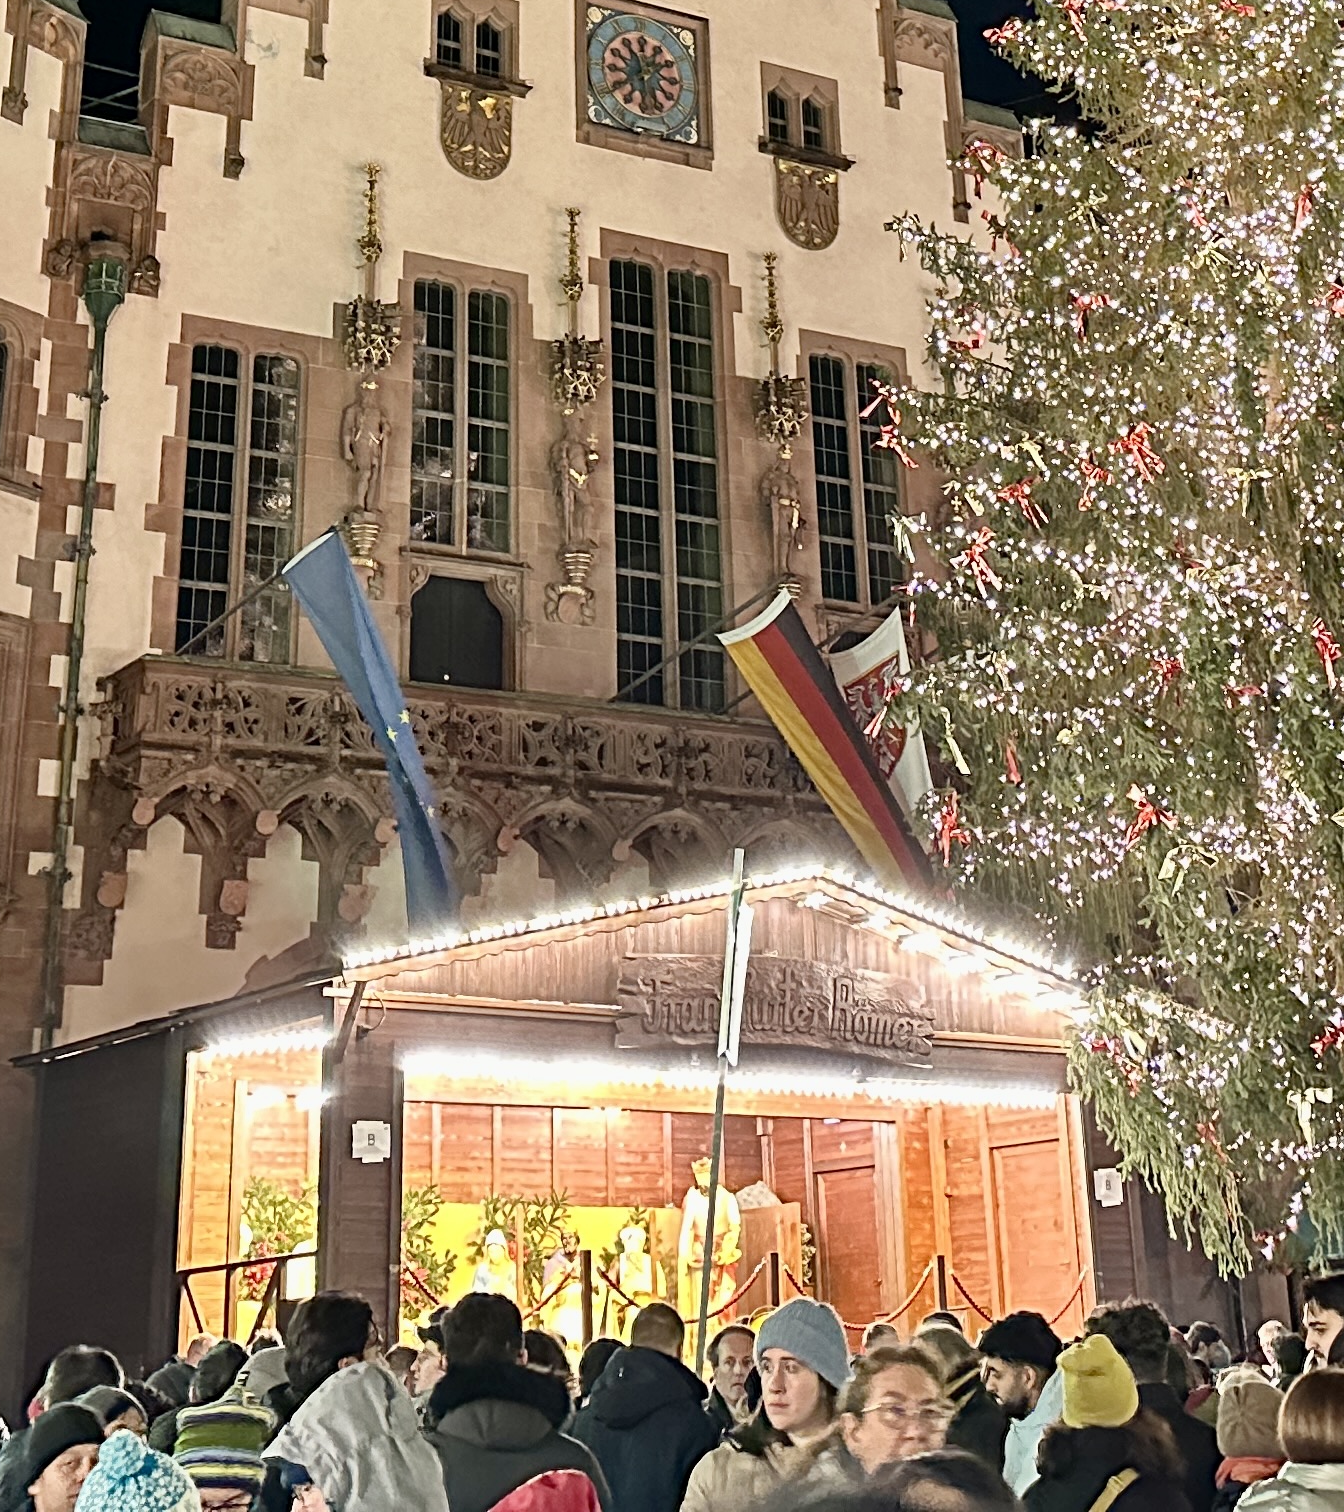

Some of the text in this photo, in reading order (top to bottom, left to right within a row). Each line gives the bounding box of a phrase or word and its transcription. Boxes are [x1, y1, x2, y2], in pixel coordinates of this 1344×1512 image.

[832, 976, 932, 1055] Römer
[367, 1133, 376, 1147] B
[1105, 1179, 1112, 1191] B
